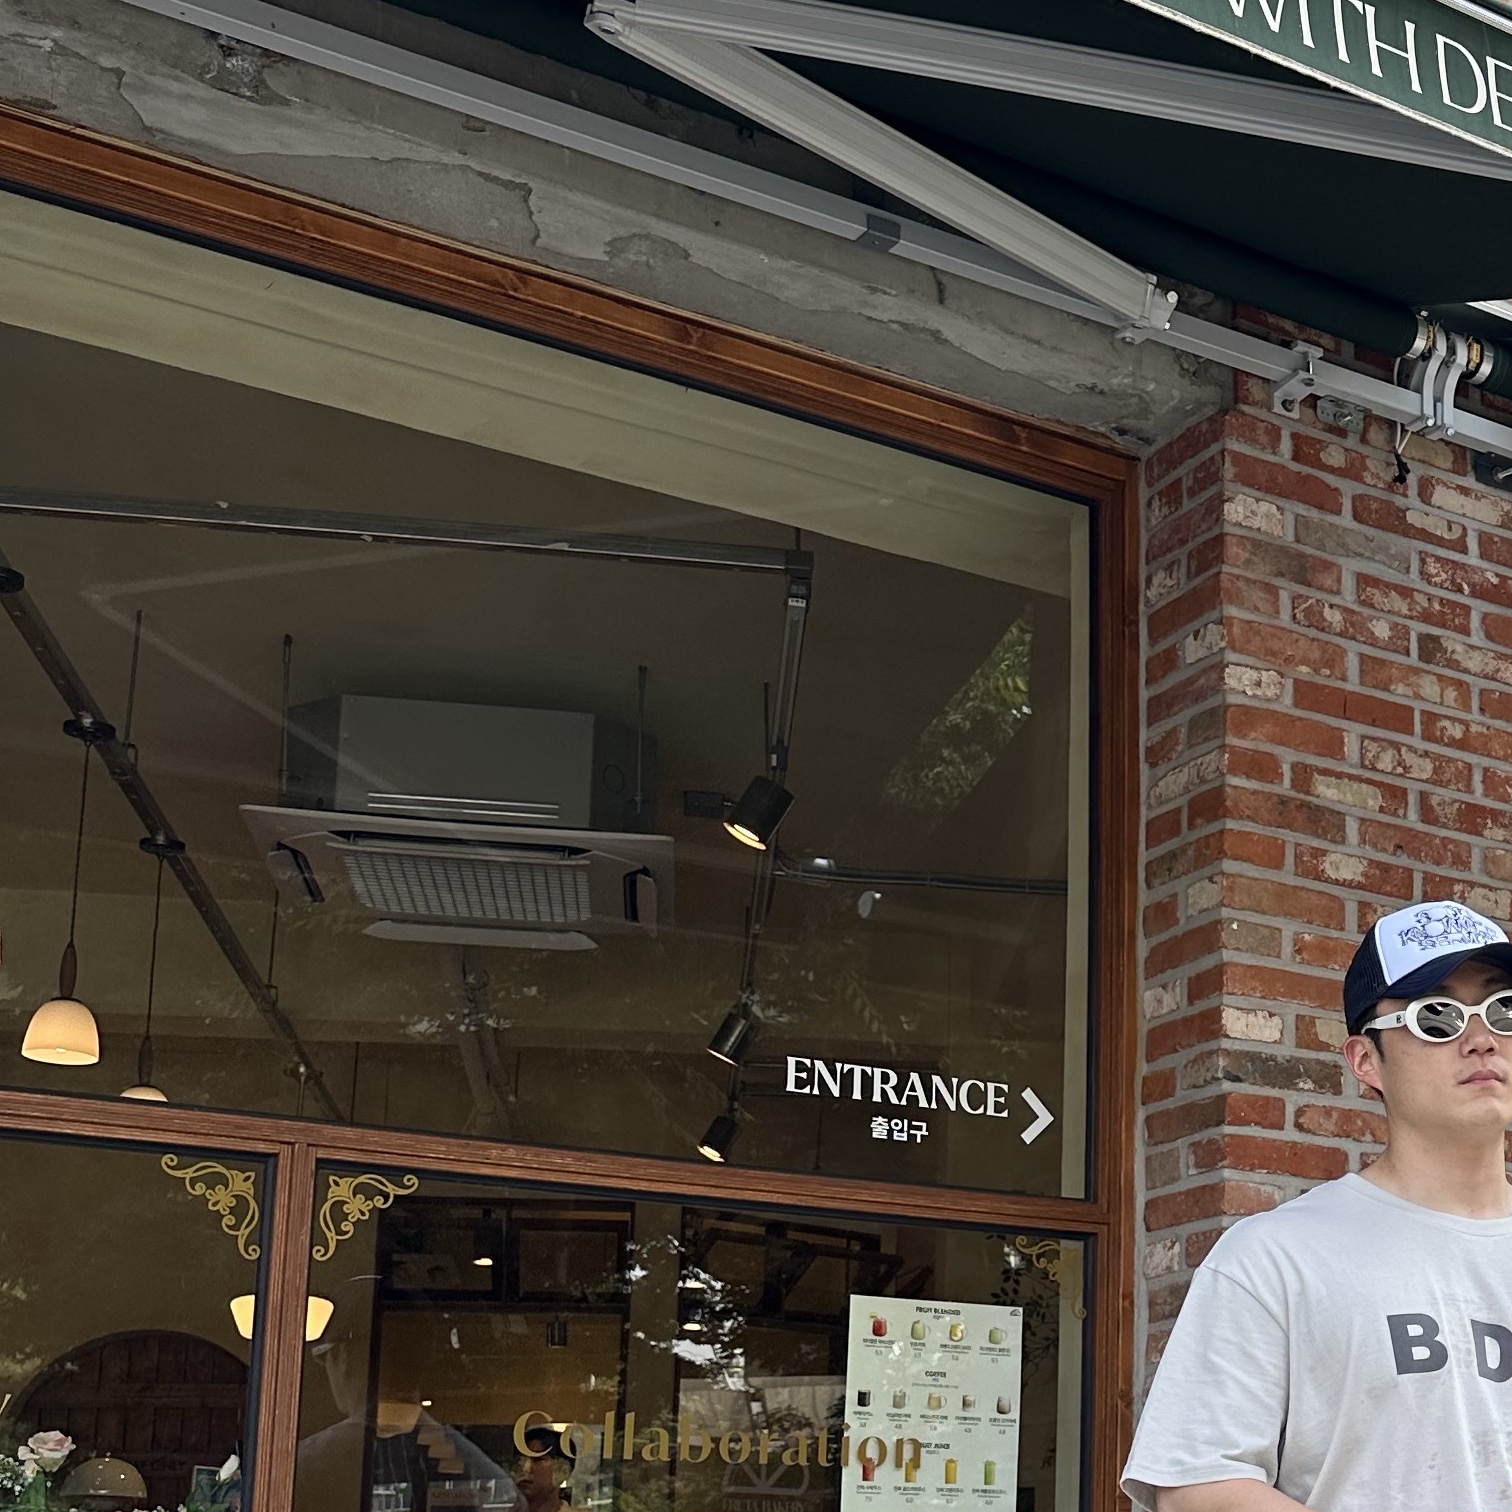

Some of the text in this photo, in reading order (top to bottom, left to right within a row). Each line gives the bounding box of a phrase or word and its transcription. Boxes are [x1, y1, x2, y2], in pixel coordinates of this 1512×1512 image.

[786, 1055, 1009, 1118] ENTRANCE
[870, 1115, 929, 1144] 출입구
[513, 1410, 921, 1469] Collaboration
